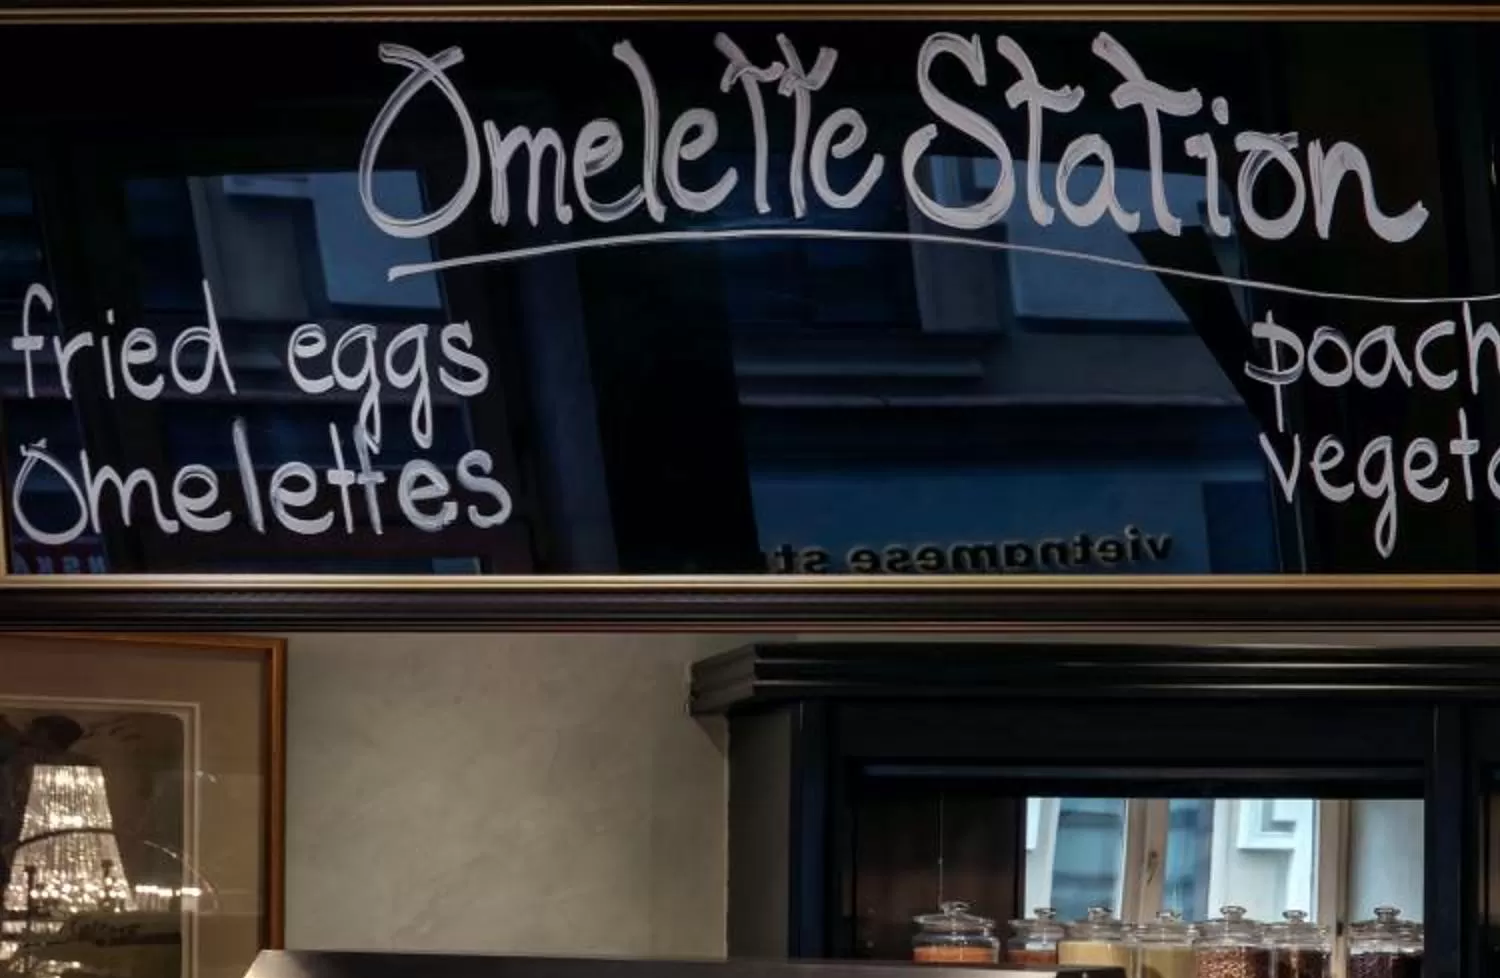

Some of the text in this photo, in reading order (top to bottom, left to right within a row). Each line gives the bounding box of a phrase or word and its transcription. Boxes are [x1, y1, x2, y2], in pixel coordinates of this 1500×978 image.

[360, 31, 1430, 243] Omelette Station
[12, 280, 489, 449] fried eggs
